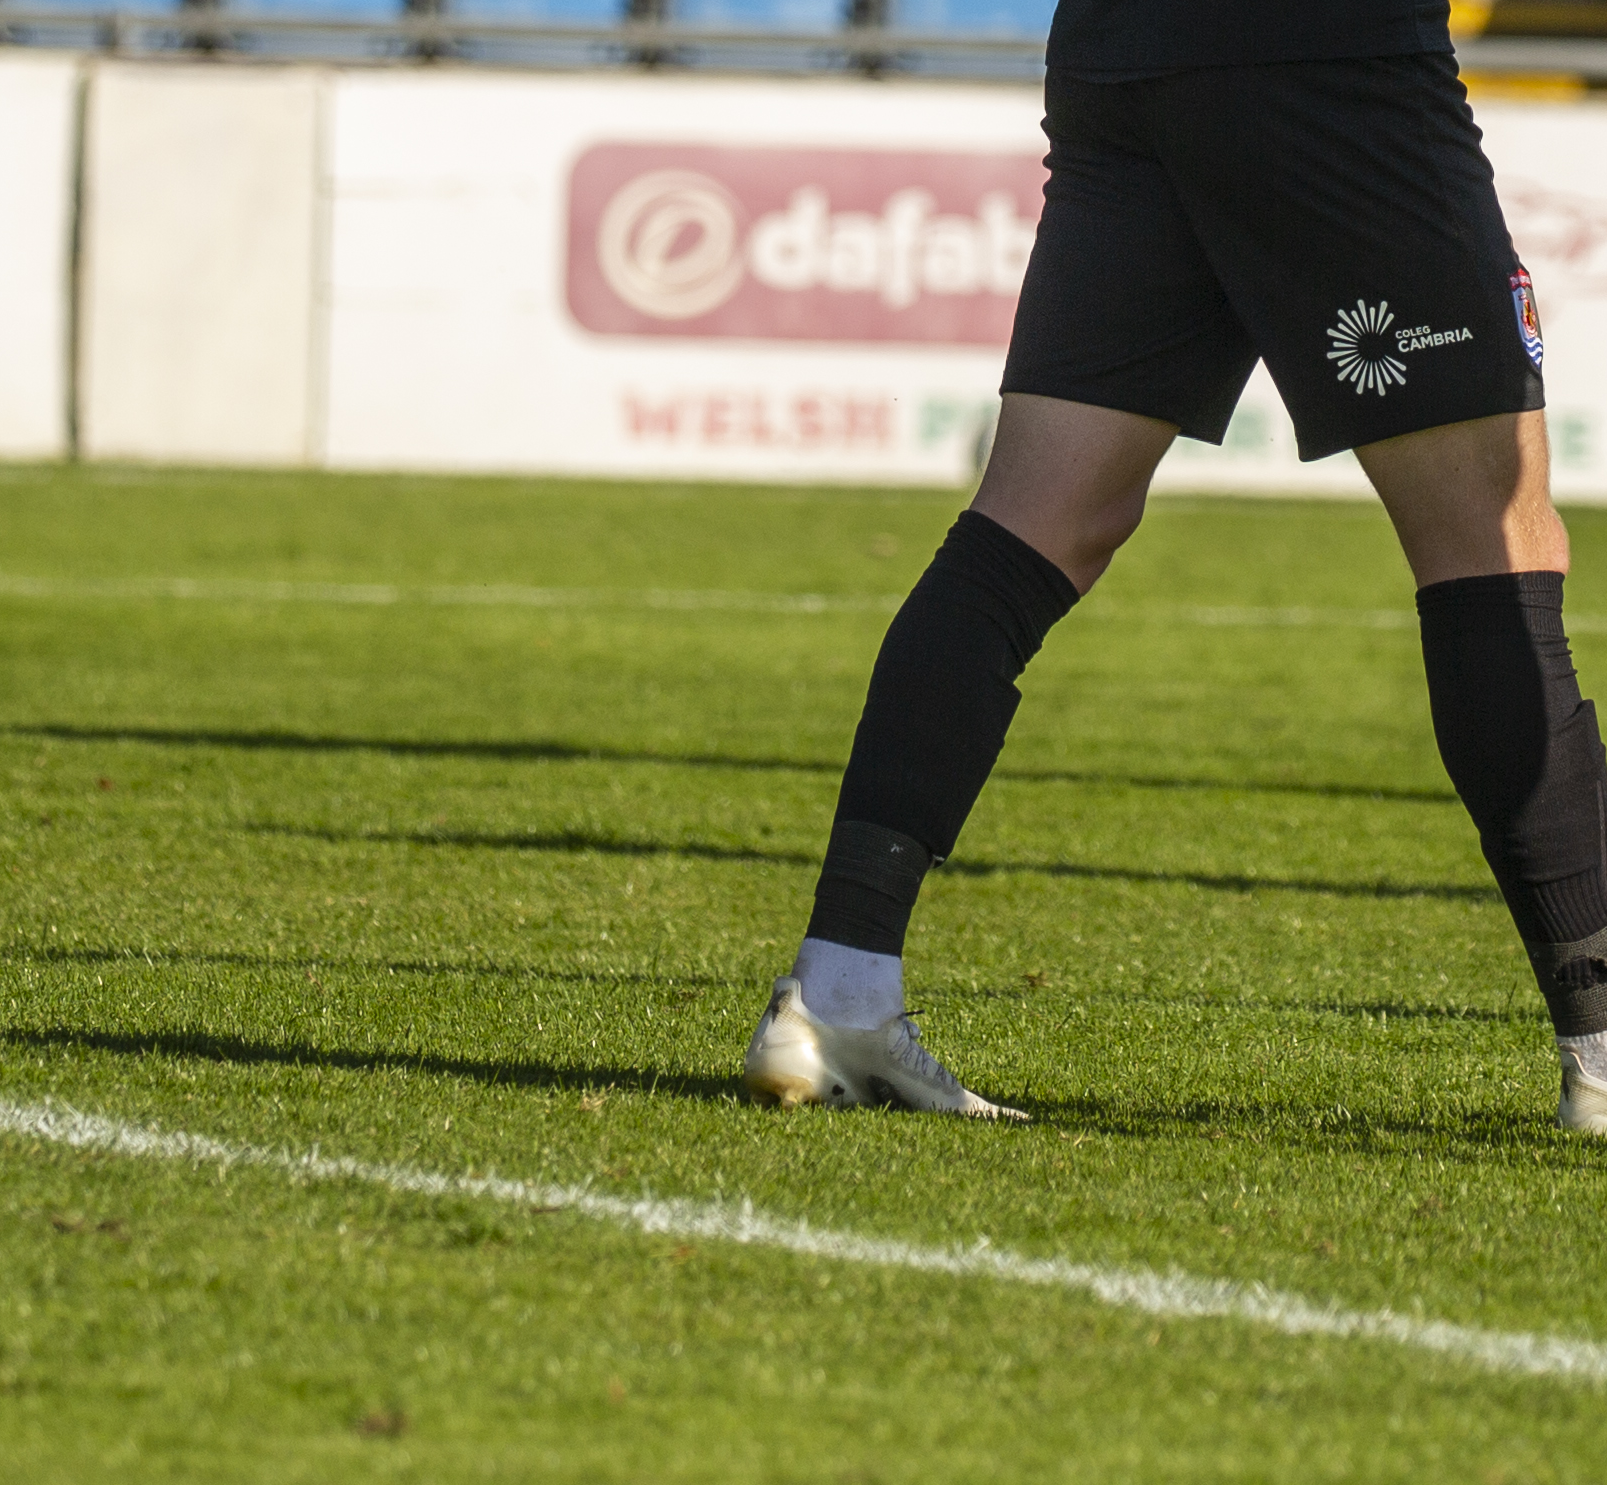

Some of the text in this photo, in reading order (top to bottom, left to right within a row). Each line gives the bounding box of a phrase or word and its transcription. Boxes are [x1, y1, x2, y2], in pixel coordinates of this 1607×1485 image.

[749, 188, 1038, 308] dafab
[1395, 325, 1431, 339] COLEG
[1398, 327, 1473, 352] CAMBRIA
